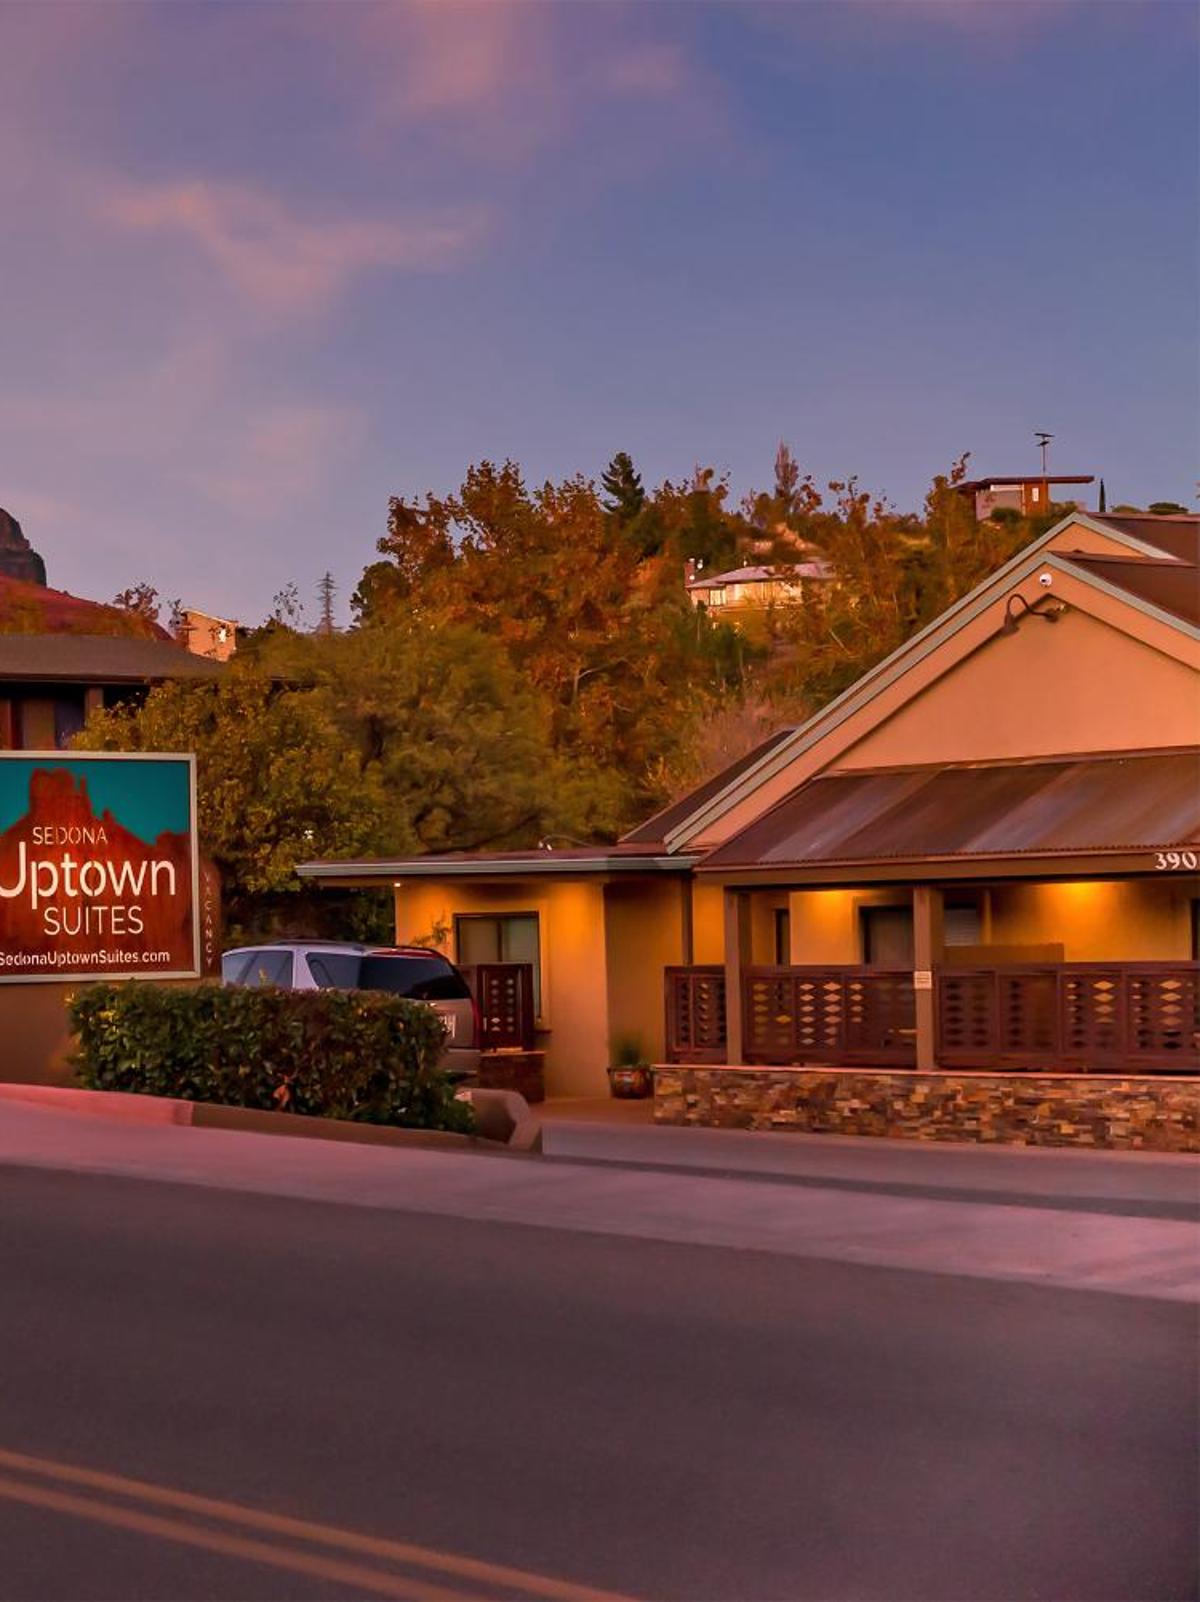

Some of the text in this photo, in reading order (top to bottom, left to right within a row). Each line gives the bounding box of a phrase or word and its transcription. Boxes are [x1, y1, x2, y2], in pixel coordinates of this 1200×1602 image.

[32, 826, 109, 845] SEDONA
[1154, 852, 1197, 870] 390
[43, 905, 144, 936] SUITES
